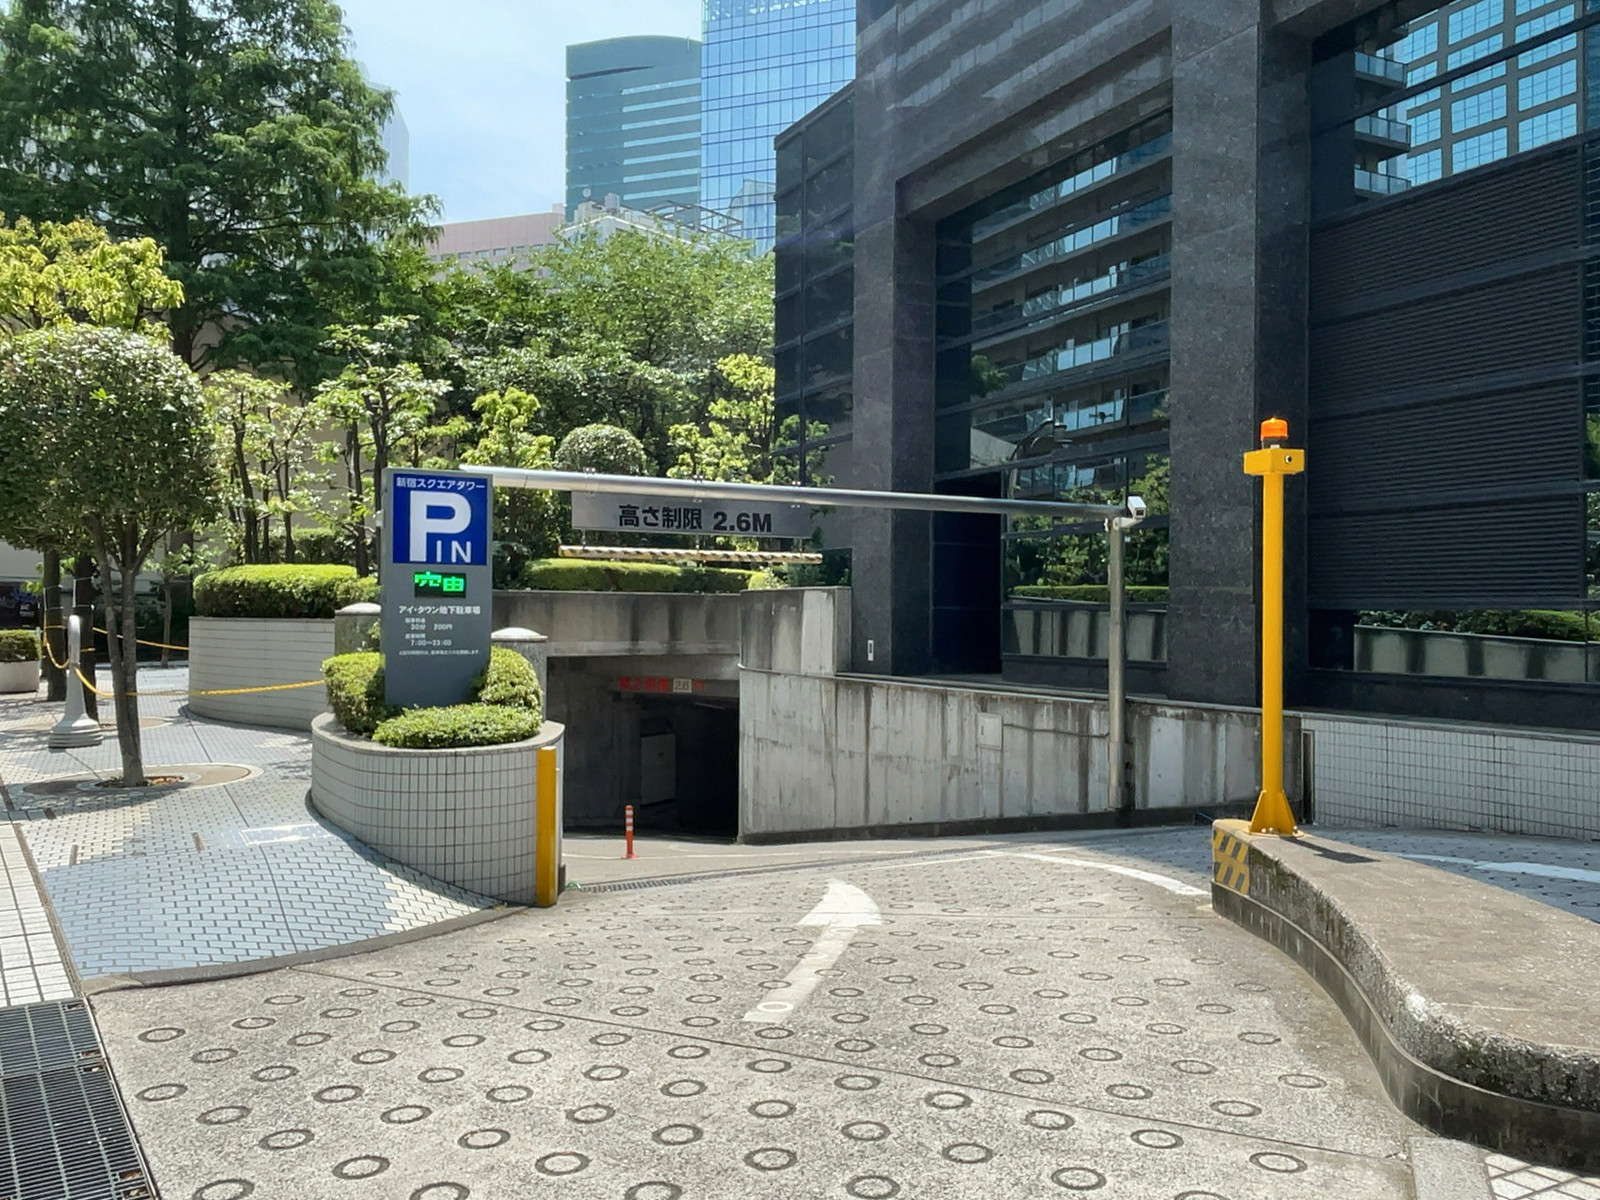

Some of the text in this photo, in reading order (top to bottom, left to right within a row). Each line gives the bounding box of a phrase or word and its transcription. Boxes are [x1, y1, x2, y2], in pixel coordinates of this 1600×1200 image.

[396, 477, 485, 491] 新宿スクエアタワー
[410, 490, 472, 562] P
[618, 504, 772, 532] 高さ制限 2.6M
[436, 540, 472, 563] IN
